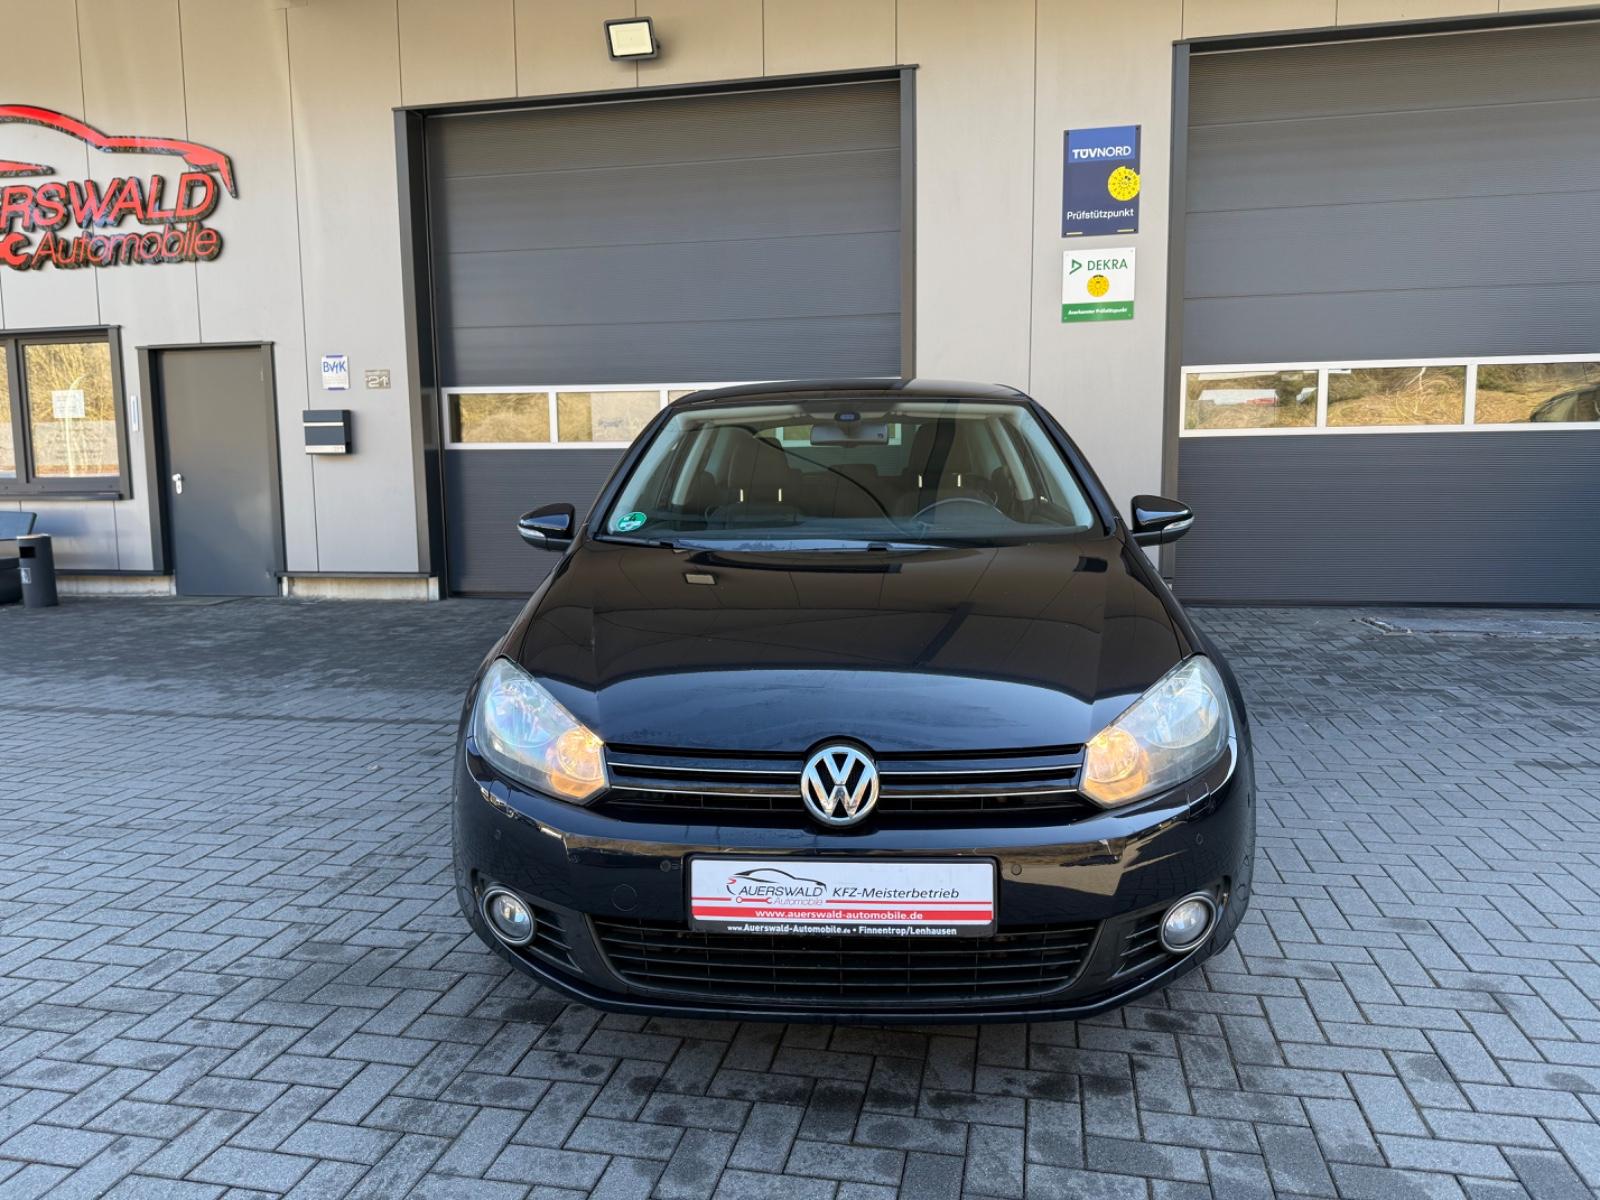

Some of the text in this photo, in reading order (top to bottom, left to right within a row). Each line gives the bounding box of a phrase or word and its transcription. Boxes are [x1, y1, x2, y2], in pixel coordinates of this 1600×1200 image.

[0, 171, 217, 231] RSWALD
[1067, 208, 1134, 220] Prüfstützpunkt
[31, 222, 220, 268] Automobile
[1087, 258, 1128, 271] DEKRA
[739, 885, 823, 897] AUERSWALD
[832, 887, 959, 899] KFZ-Meisterbetrieb
[755, 909, 923, 920] www.auerswald-automobile.de
[727, 923, 957, 936] www.Auerswald-Automobile.de Finnentrop/Lenhausen
